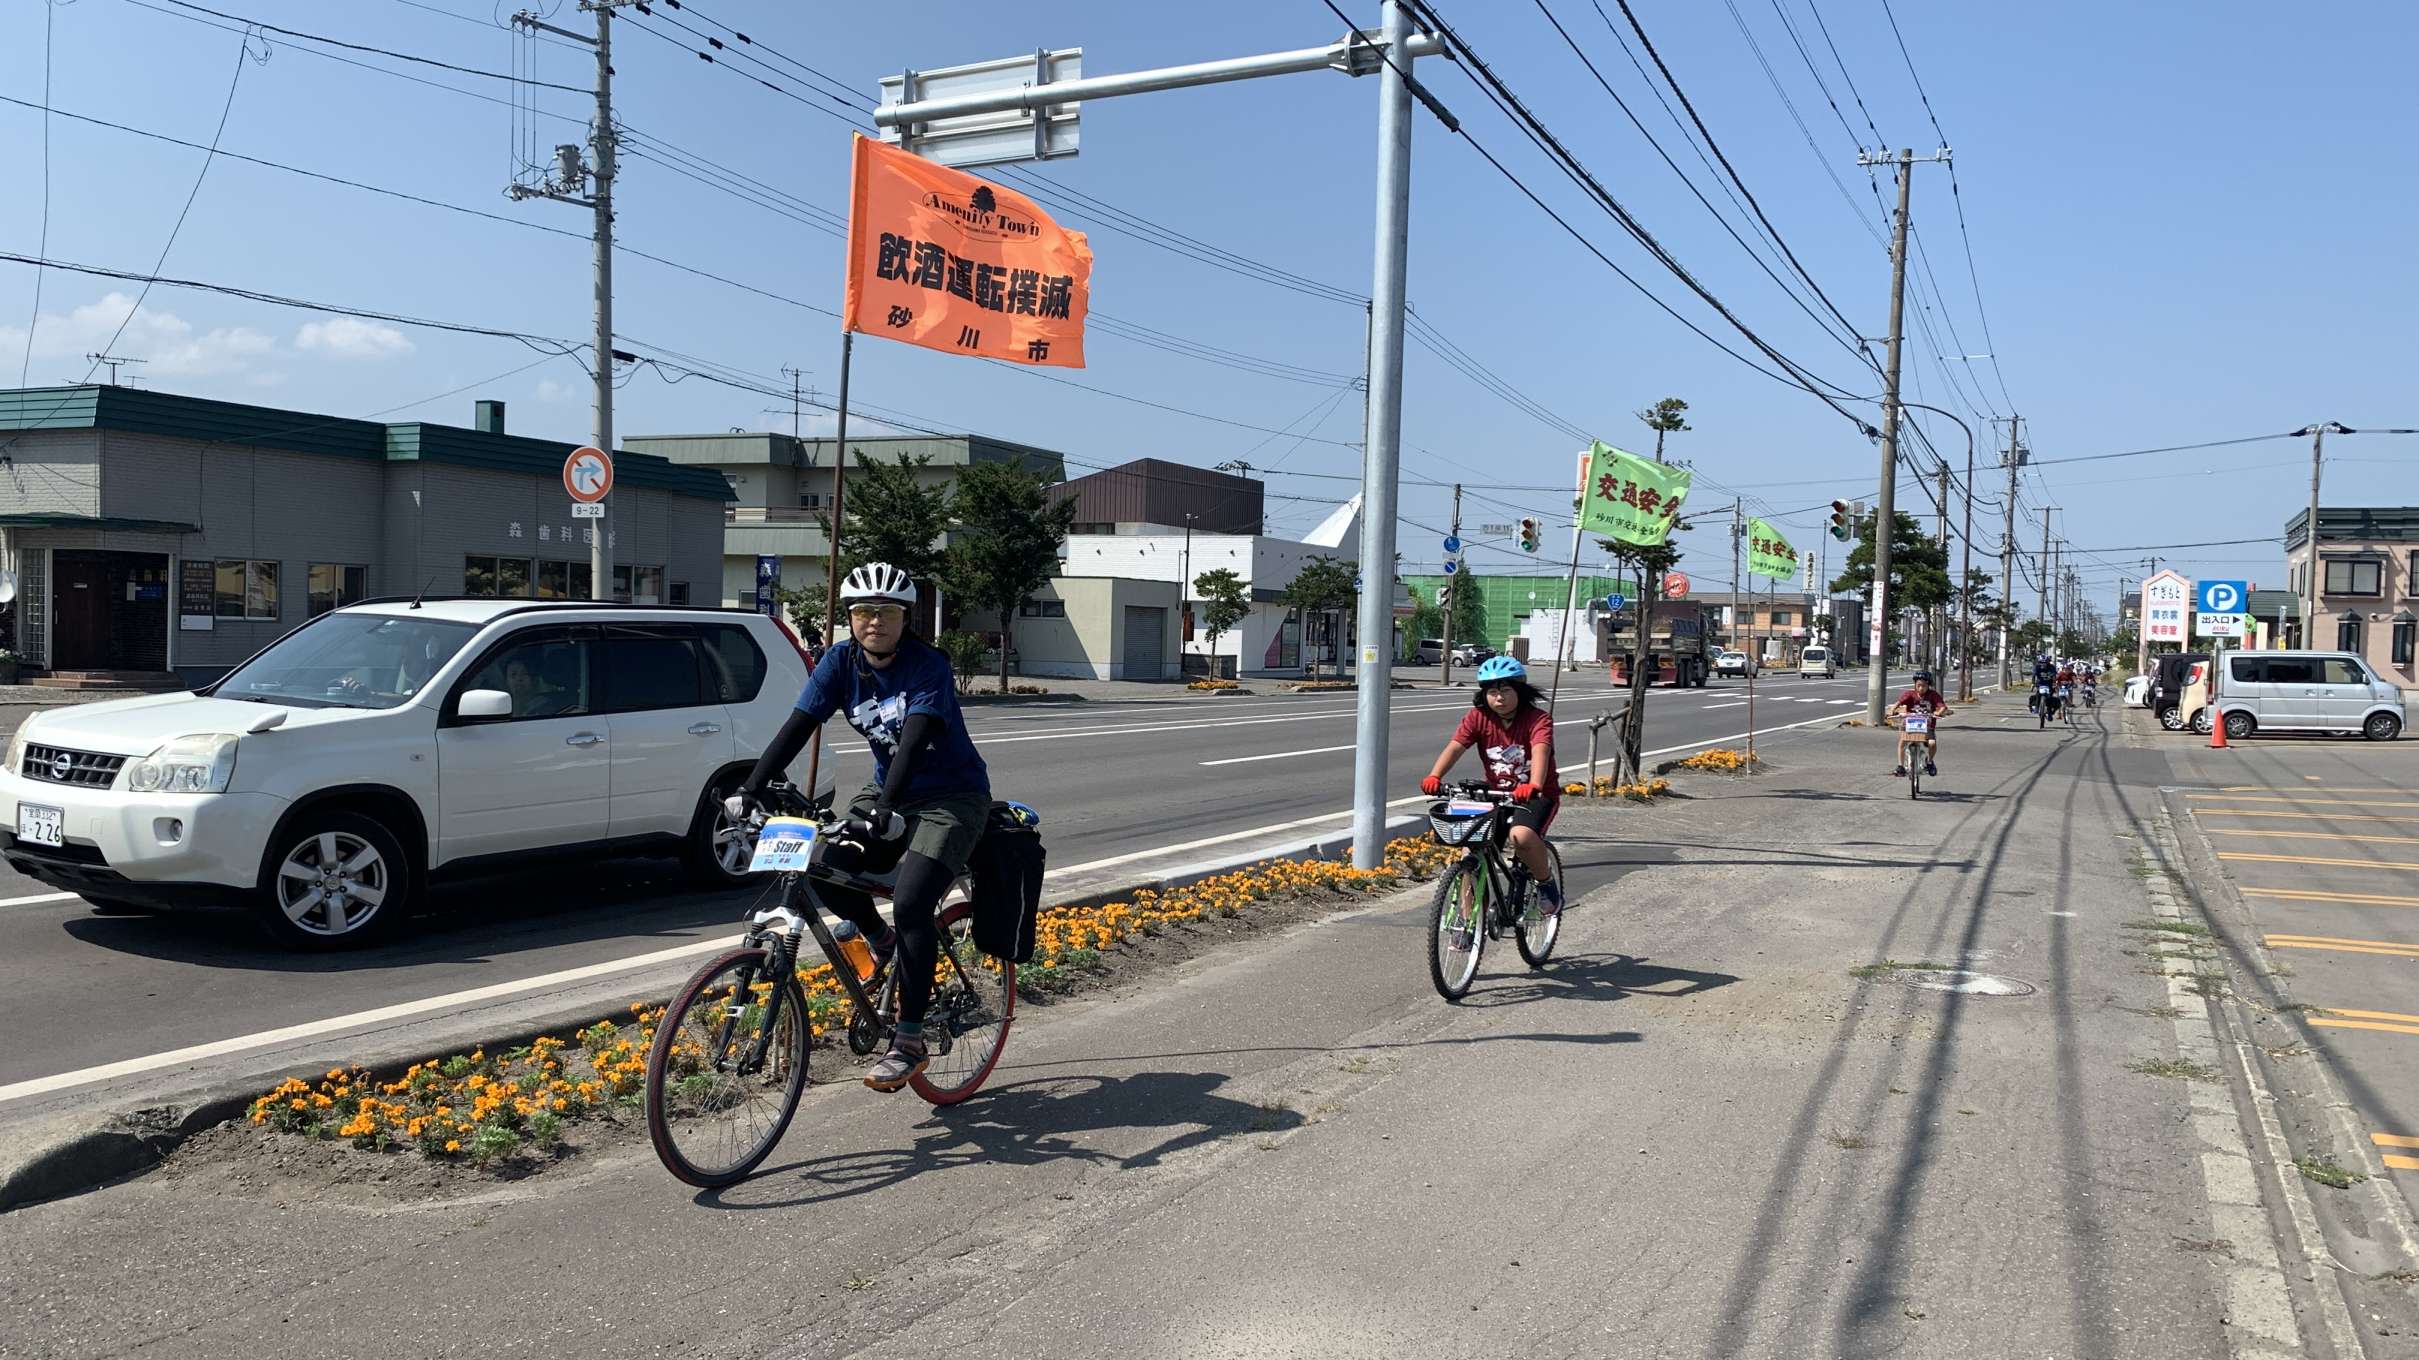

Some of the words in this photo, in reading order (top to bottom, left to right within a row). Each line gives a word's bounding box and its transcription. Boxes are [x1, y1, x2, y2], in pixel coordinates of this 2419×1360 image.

[925, 194, 993, 229] Amenity
[997, 214, 1040, 236] Town
[877, 232, 1074, 320] 飲酒運転撲滅
[887, 305, 1050, 361] 砂川市
[576, 506, 599, 515] 9-22
[1752, 535, 1798, 562] 交通安全
[1611, 598, 1620, 606] 12
[2213, 587, 2232, 607] P
[2202, 616, 2229, 624] 出入口
[2151, 625, 2177, 635] 美容室
[773, 840, 804, 853] Staff
